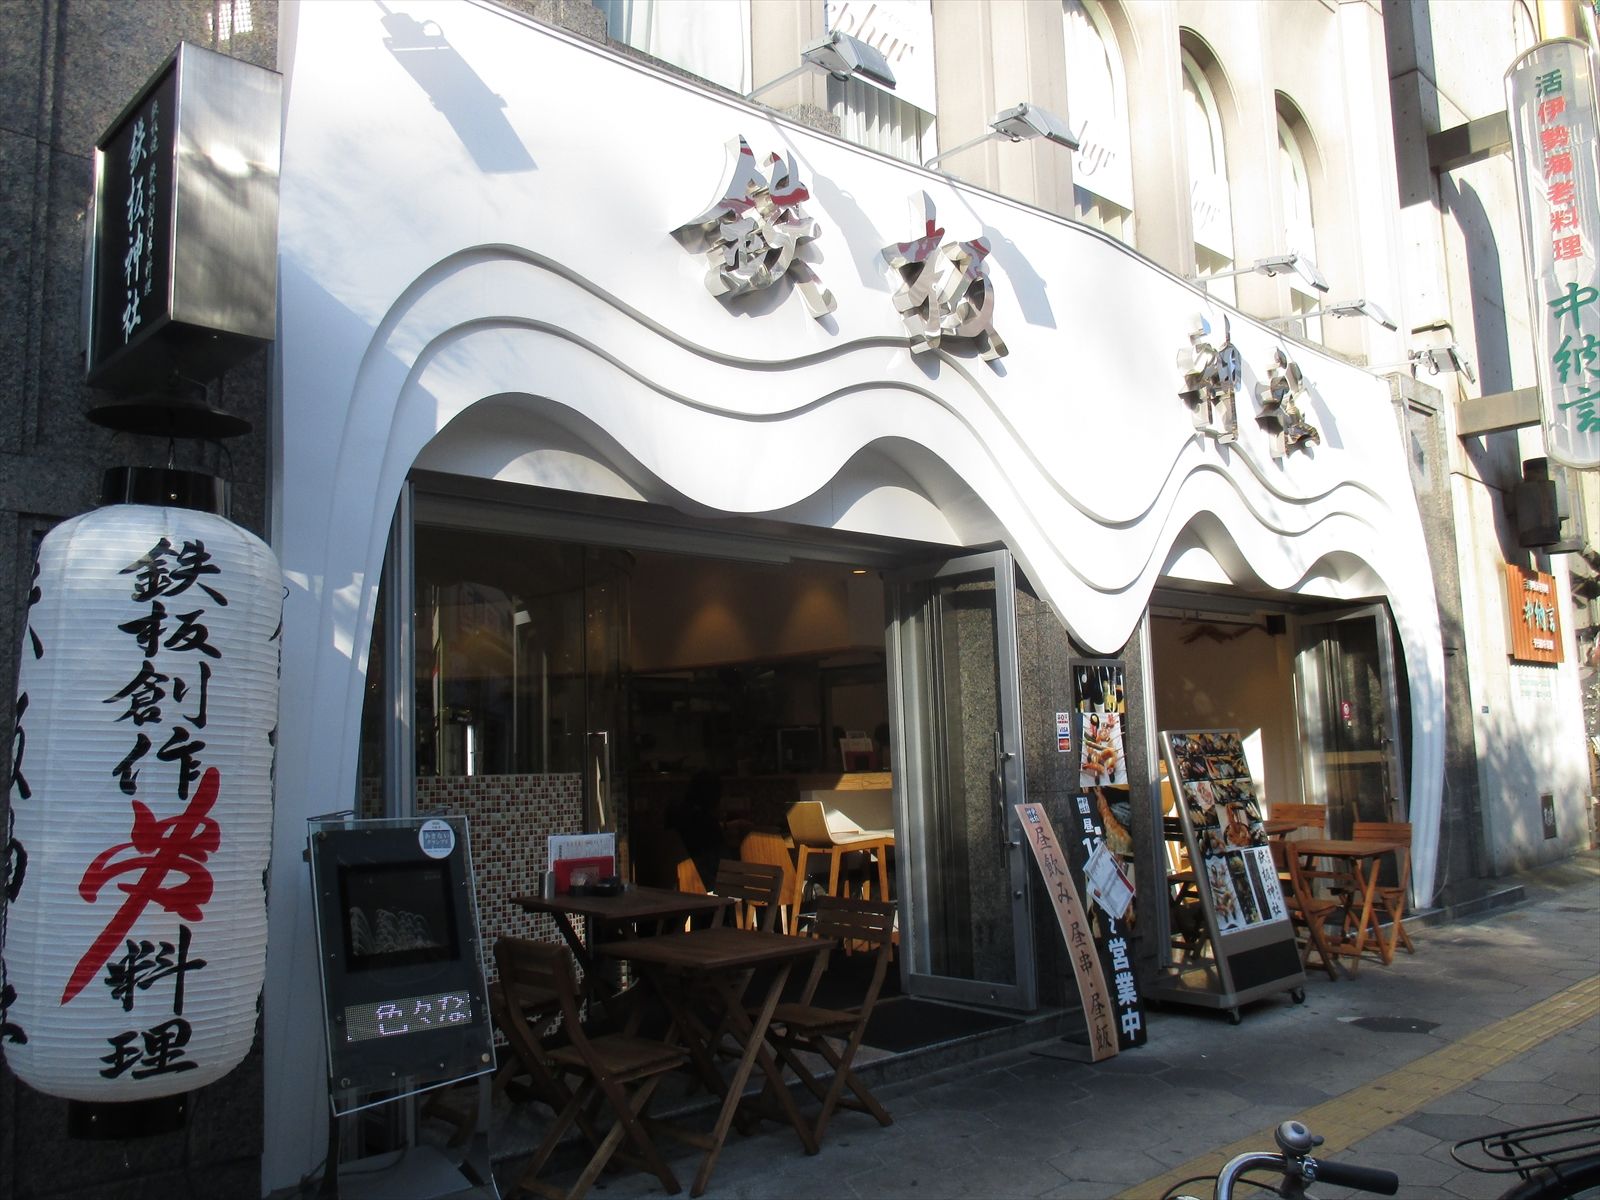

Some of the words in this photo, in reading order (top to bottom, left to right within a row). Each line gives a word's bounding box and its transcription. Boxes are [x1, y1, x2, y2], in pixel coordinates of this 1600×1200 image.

[122, 117, 148, 344] 鉄板神社
[1535, 68, 1583, 261] 活伊勢海老料理
[1547, 282, 1600, 433] 中納言
